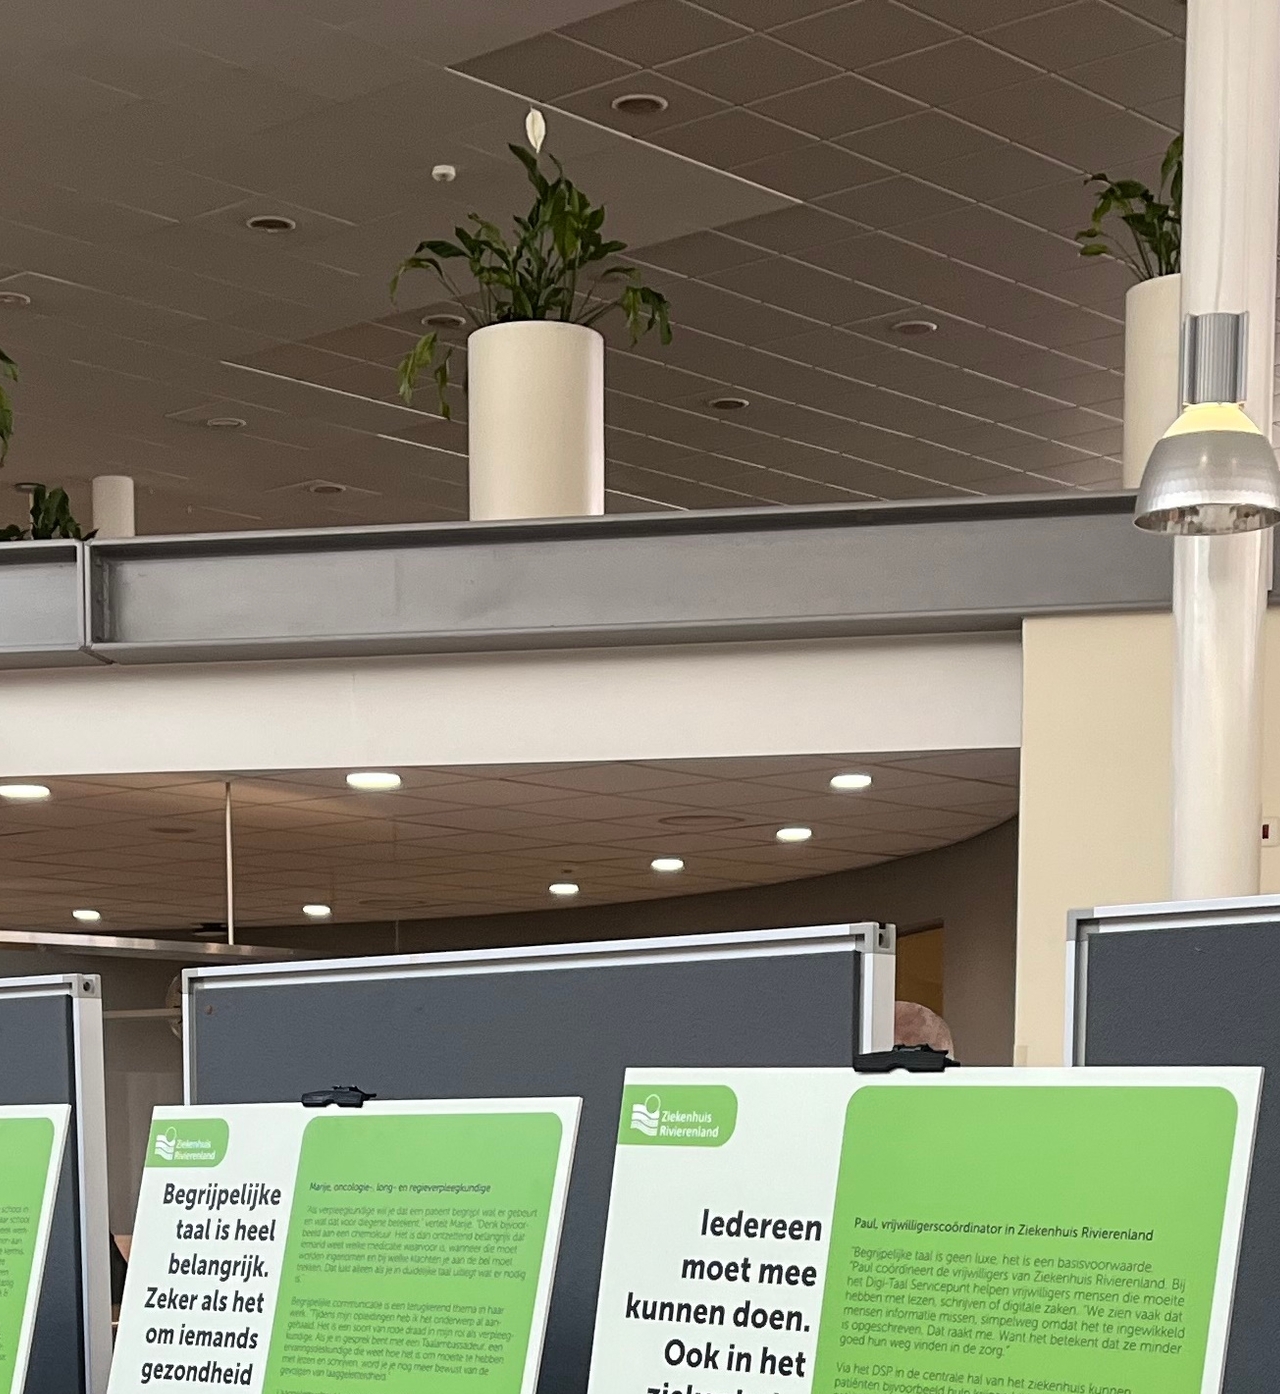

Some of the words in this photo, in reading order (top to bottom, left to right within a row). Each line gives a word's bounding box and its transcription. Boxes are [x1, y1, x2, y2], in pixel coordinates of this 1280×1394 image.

[661, 1110, 712, 1123] Ziekenhuis
[659, 1125, 720, 1138] Rivierenland
[163, 1183, 282, 1212] Begrijpelijke
[176, 1218, 212, 1240] taal
[215, 1218, 231, 1241] is
[234, 1218, 277, 1242] heel
[701, 1208, 822, 1242] Iedereen
[1004, 1226, 1016, 1235] in
[1017, 1223, 1078, 1238] Ziekenhuis
[1081, 1226, 1154, 1242] Rivierenland
[168, 1253, 269, 1283] belangrijk.
[681, 1257, 752, 1283] moet
[758, 1263, 817, 1287] mee
[144, 1286, 199, 1311] Zeker
[201, 1289, 228, 1312] als
[232, 1290, 265, 1314] het
[846, 1275, 864, 1288] het
[910, 1278, 971, 1295] Servicepunt
[972, 1283, 1010, 1298] helpen
[1012, 1287, 1071, 1302] vrijwilligers
[1074, 1291, 1120, 1303] mensen
[1122, 1291, 1141, 1304] die
[1143, 1295, 1185, 1307] moeite
[625, 1292, 726, 1326] kunnen
[732, 1300, 810, 1333] doen.
[145, 1327, 175, 1345] om
[178, 1323, 259, 1350] iemands
[140, 1360, 253, 1386] gezondheid
[664, 1339, 720, 1370] Ook
[726, 1343, 752, 1373] in
[759, 1346, 807, 1378] het
[836, 1361, 851, 1374] Via
[853, 1363, 870, 1376] het
[872, 1364, 894, 1377] DSP
[895, 1369, 905, 1378] in
[906, 1368, 921, 1380] de
[922, 1371, 965, 1384] centrale
[967, 1373, 983, 1386] hal
[985, 1377, 1005, 1387] van
[1007, 1376, 1025, 1389] het
[1027, 1380, 1086, 1394] ziekenhuis
